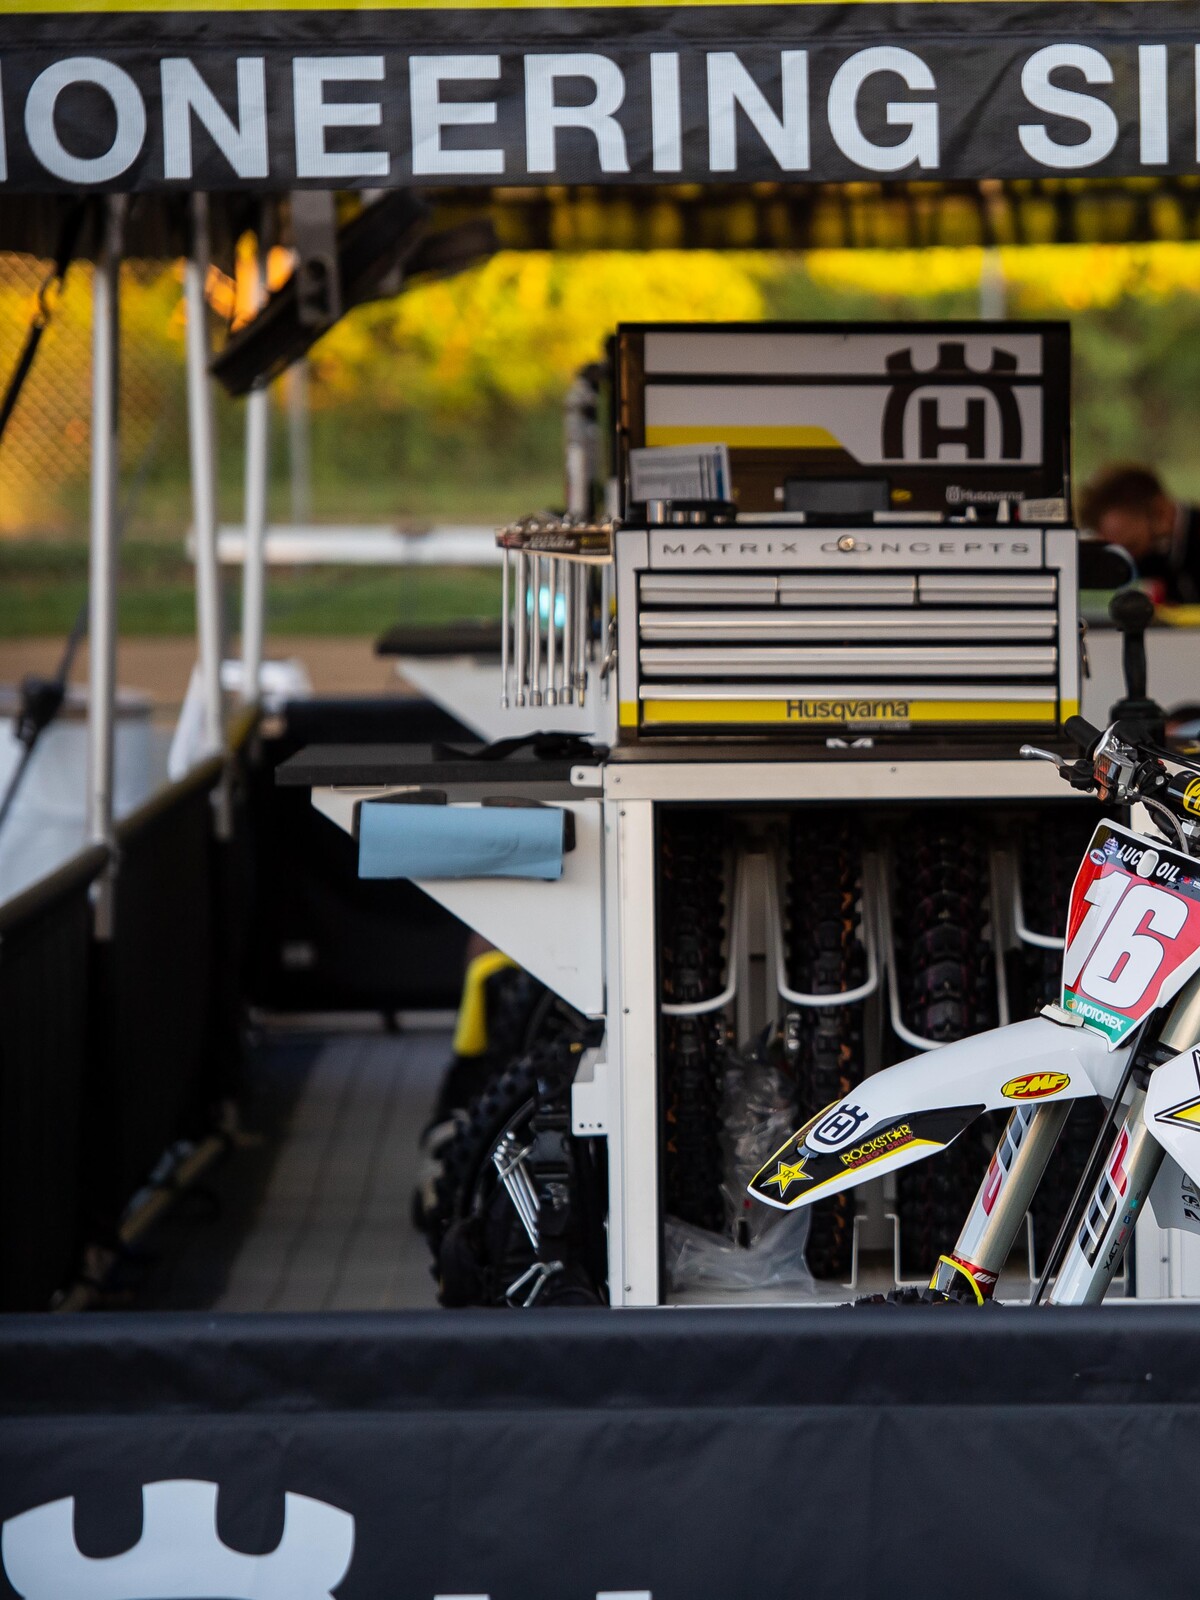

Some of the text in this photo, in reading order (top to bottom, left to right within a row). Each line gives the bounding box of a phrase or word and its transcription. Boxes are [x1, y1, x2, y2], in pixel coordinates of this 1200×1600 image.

[0, 45, 940, 184] ONEERING
[662, 542, 799, 555] MATRIX
[786, 699, 911, 721] Husqvarna
[1156, 862, 1180, 882] OIL
[1064, 870, 1190, 1009] 16
[1077, 1001, 1124, 1032] MOTOREX
[1003, 1074, 1068, 1097] FMF
[1103, 1240, 1120, 1271] XACT
